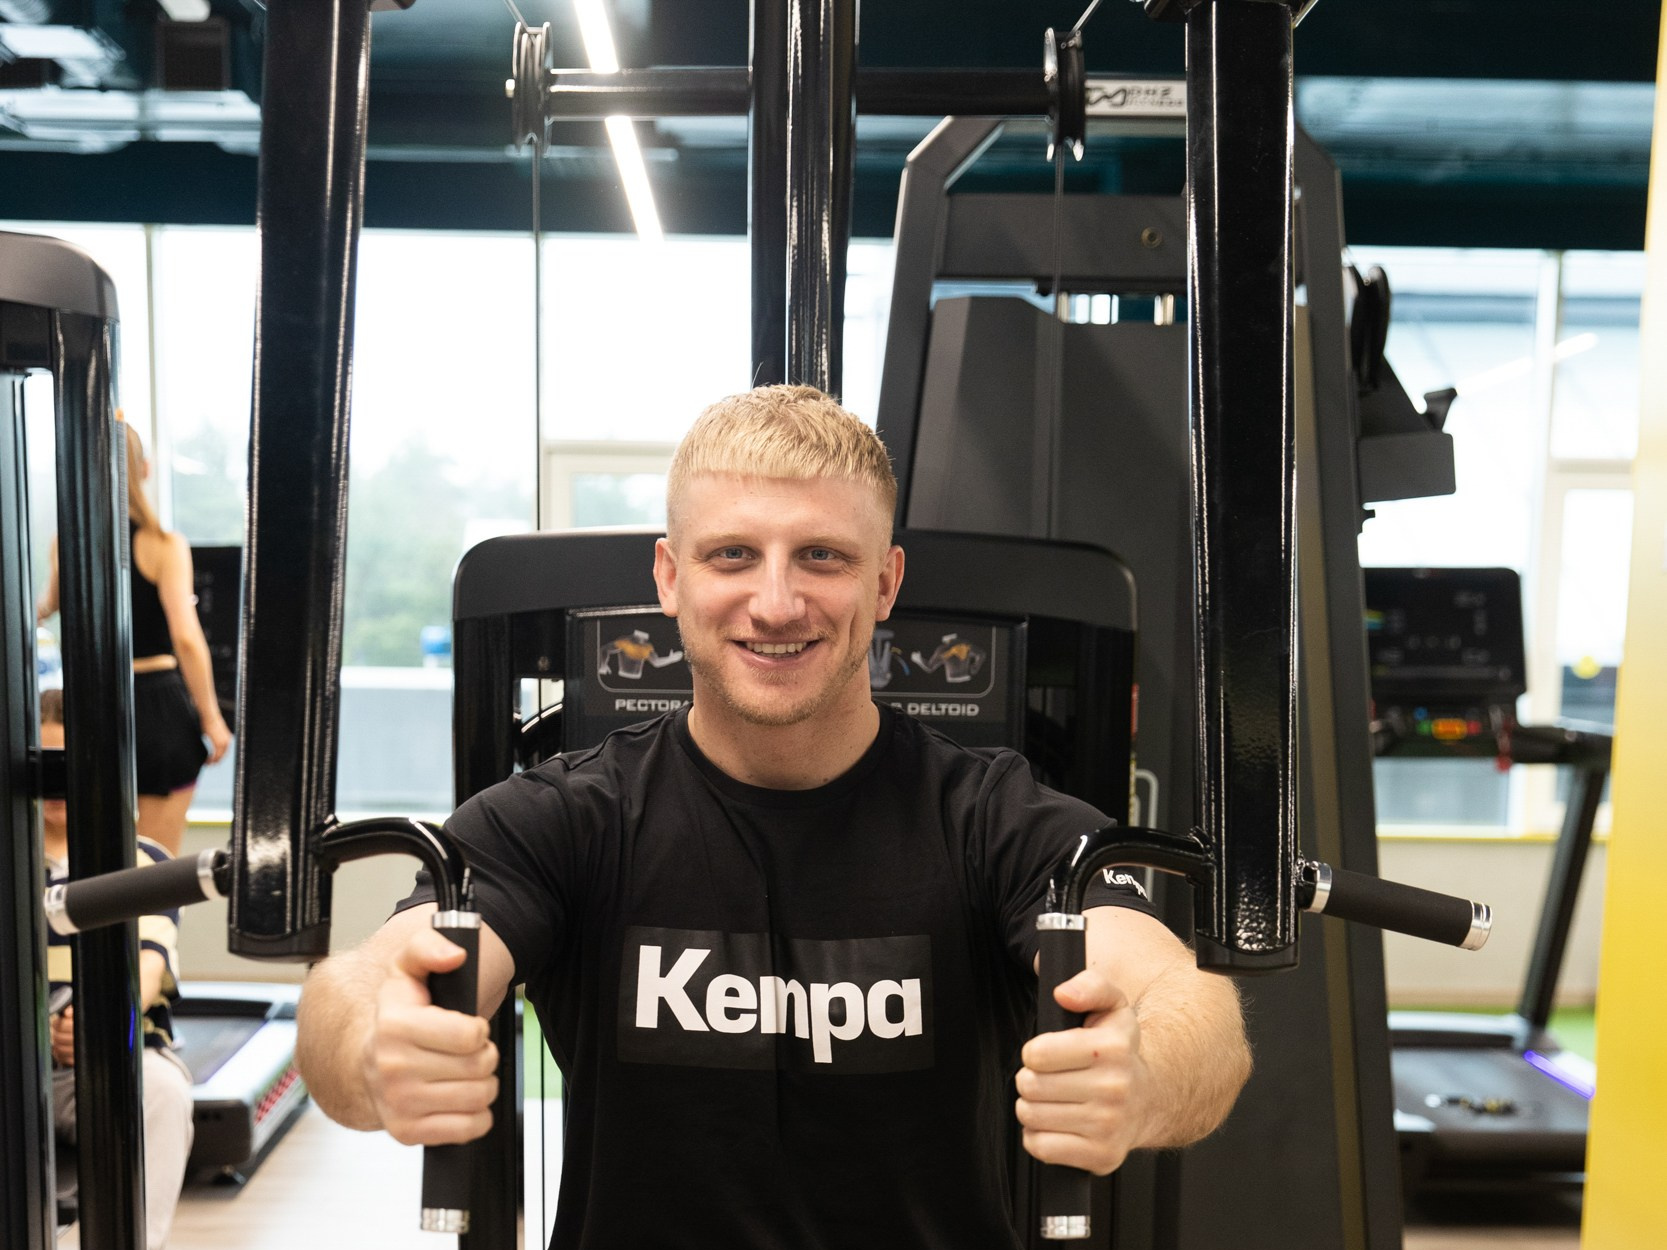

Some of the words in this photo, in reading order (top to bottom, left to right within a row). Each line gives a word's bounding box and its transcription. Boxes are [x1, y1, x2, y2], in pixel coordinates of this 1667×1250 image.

[906, 702, 980, 717] DELTOID
[1102, 868, 1148, 899] Kem
[635, 944, 923, 1064] Kempa
